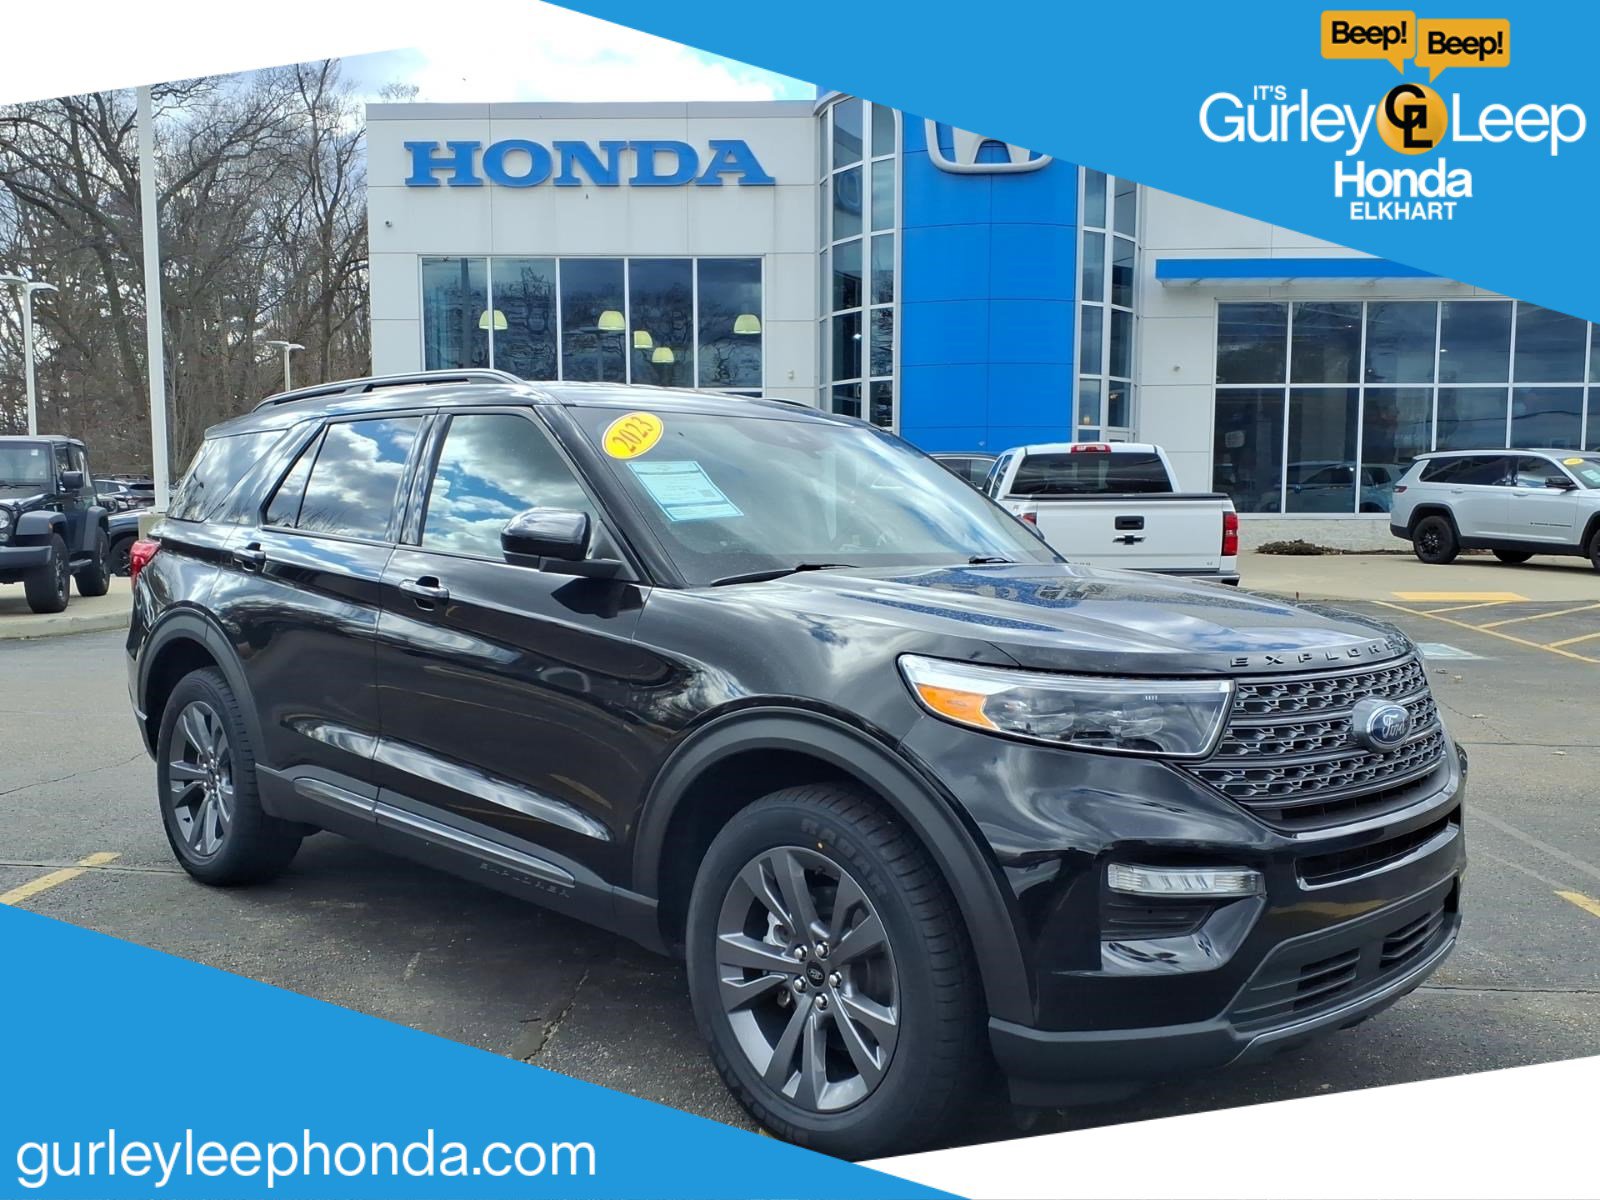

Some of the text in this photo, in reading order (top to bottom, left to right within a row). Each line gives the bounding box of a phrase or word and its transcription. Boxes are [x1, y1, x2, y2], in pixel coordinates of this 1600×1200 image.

[404, 139, 775, 187] HONDA
[612, 417, 655, 452] 2023
[1381, 714, 1407, 738] Ford
